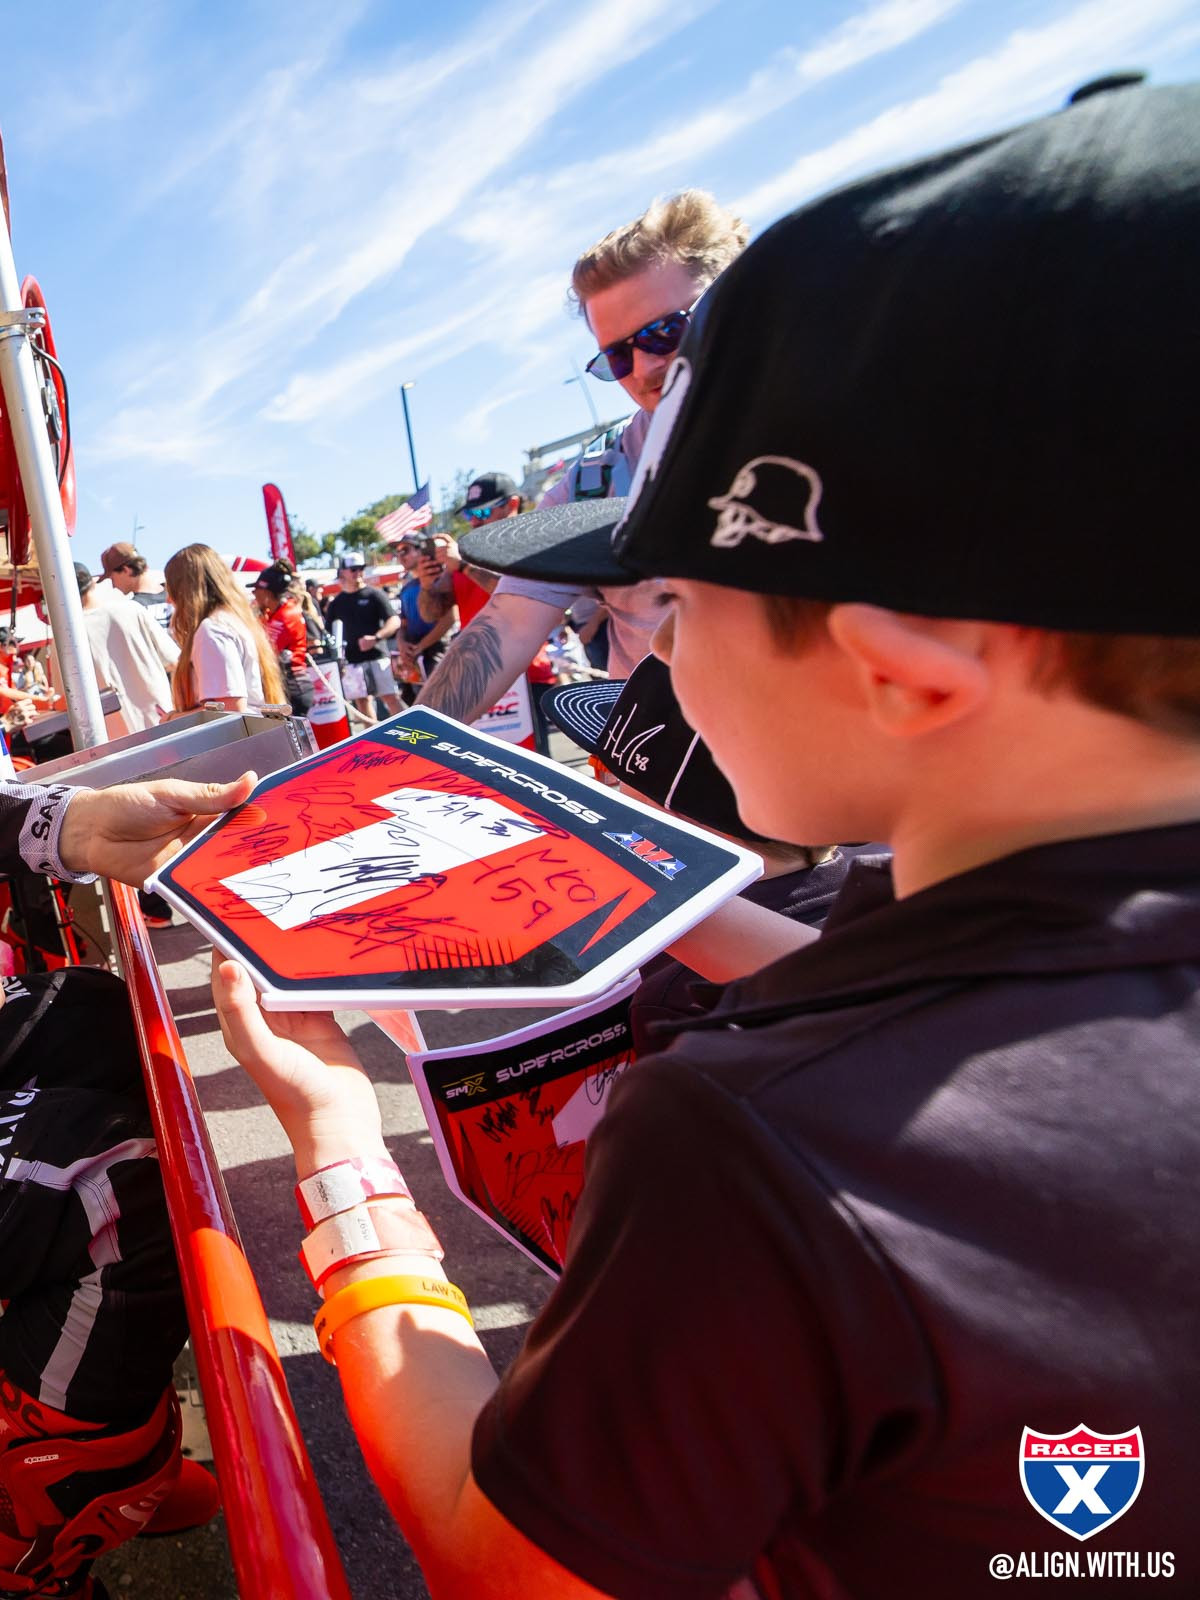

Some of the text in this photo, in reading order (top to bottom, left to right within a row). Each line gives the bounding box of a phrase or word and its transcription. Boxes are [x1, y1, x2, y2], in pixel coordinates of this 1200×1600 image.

[431, 741, 608, 825] SUPERCROSS
[495, 1022, 628, 1084] SUPERCROSS
[445, 1075, 488, 1100] SMX
